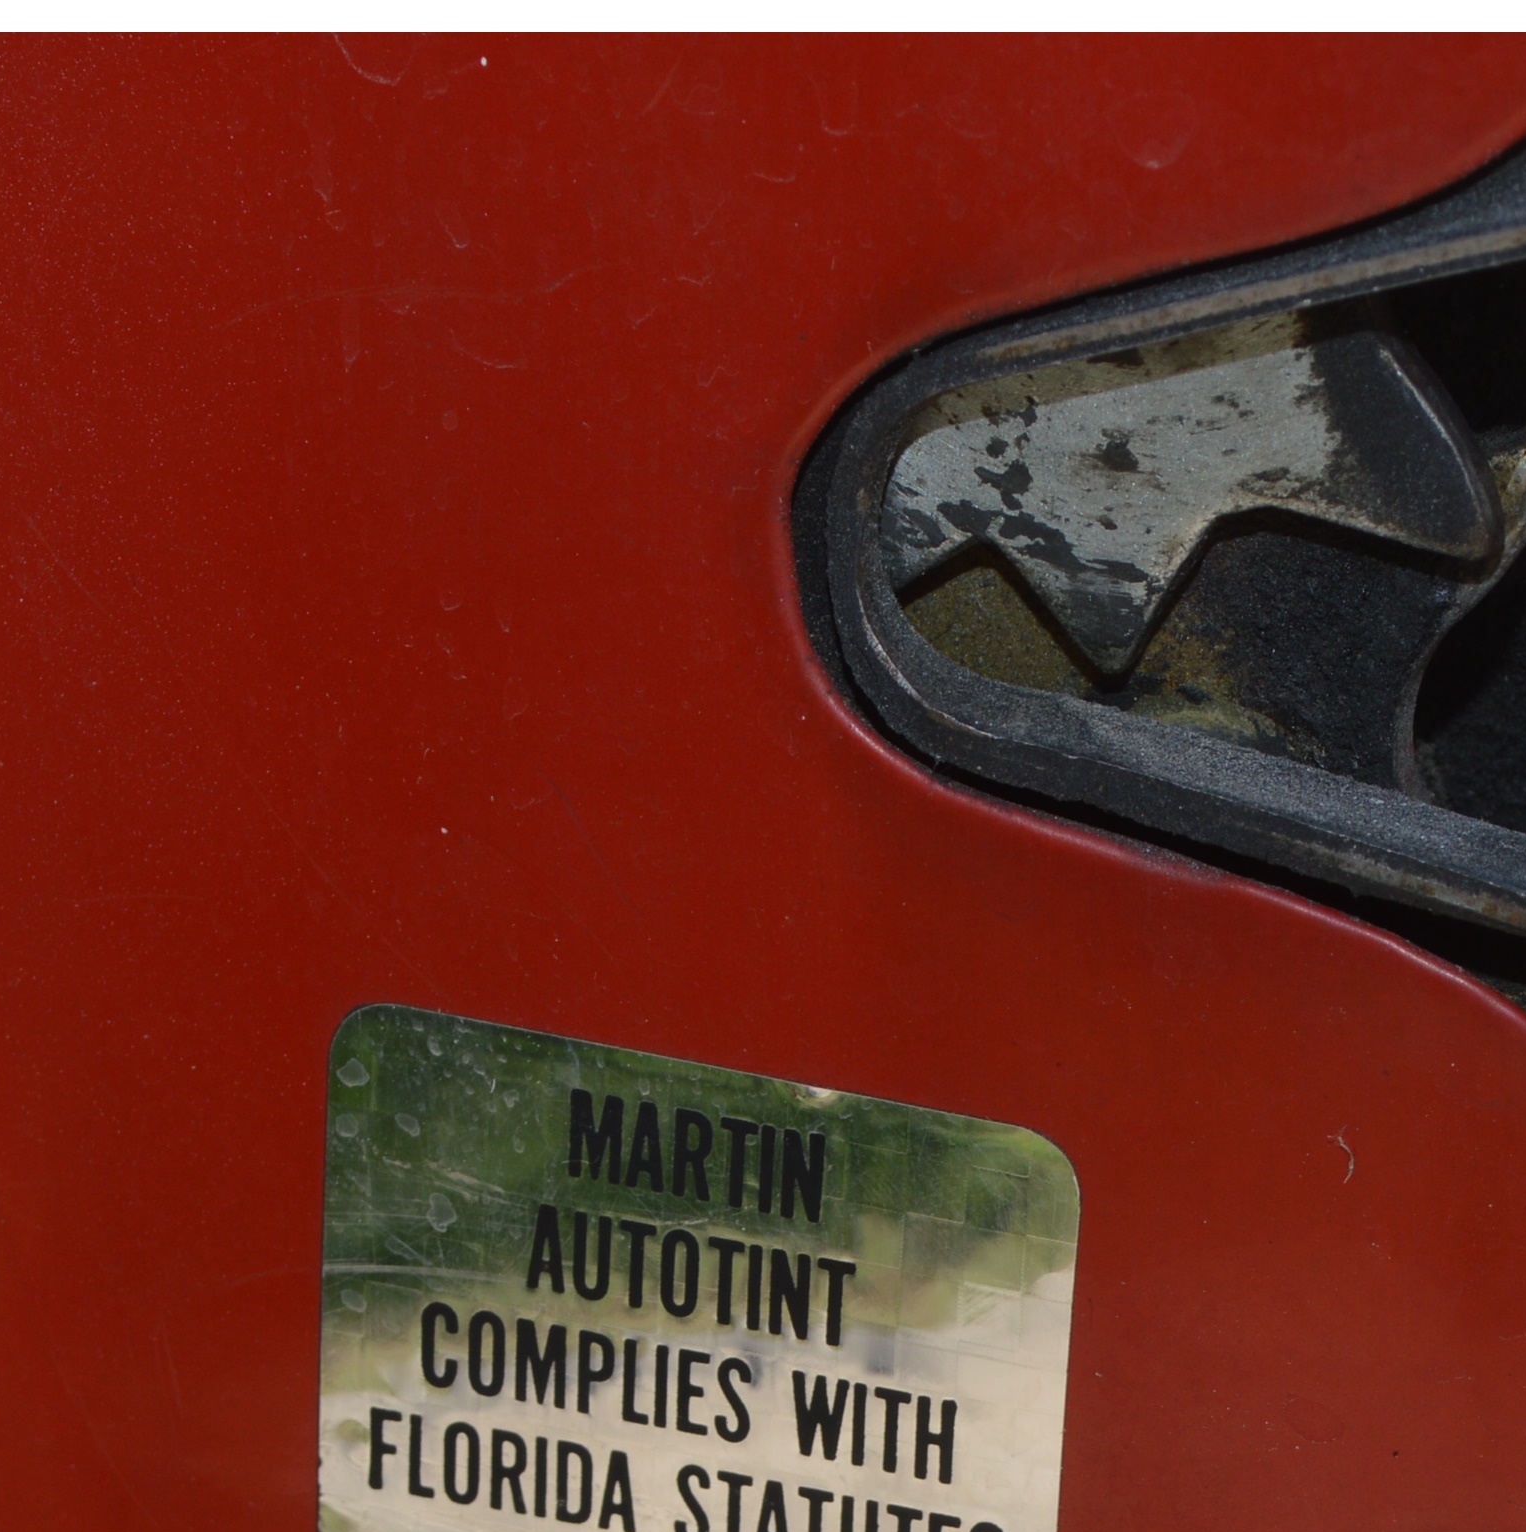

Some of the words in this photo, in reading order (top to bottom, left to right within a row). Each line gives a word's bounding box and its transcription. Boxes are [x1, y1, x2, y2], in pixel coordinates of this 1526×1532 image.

[568, 1088, 826, 1224] MARTIN
[526, 1203, 857, 1347] AUTOTINT
[420, 1301, 753, 1443] COMPLIES
[791, 1369, 958, 1485] WITH
